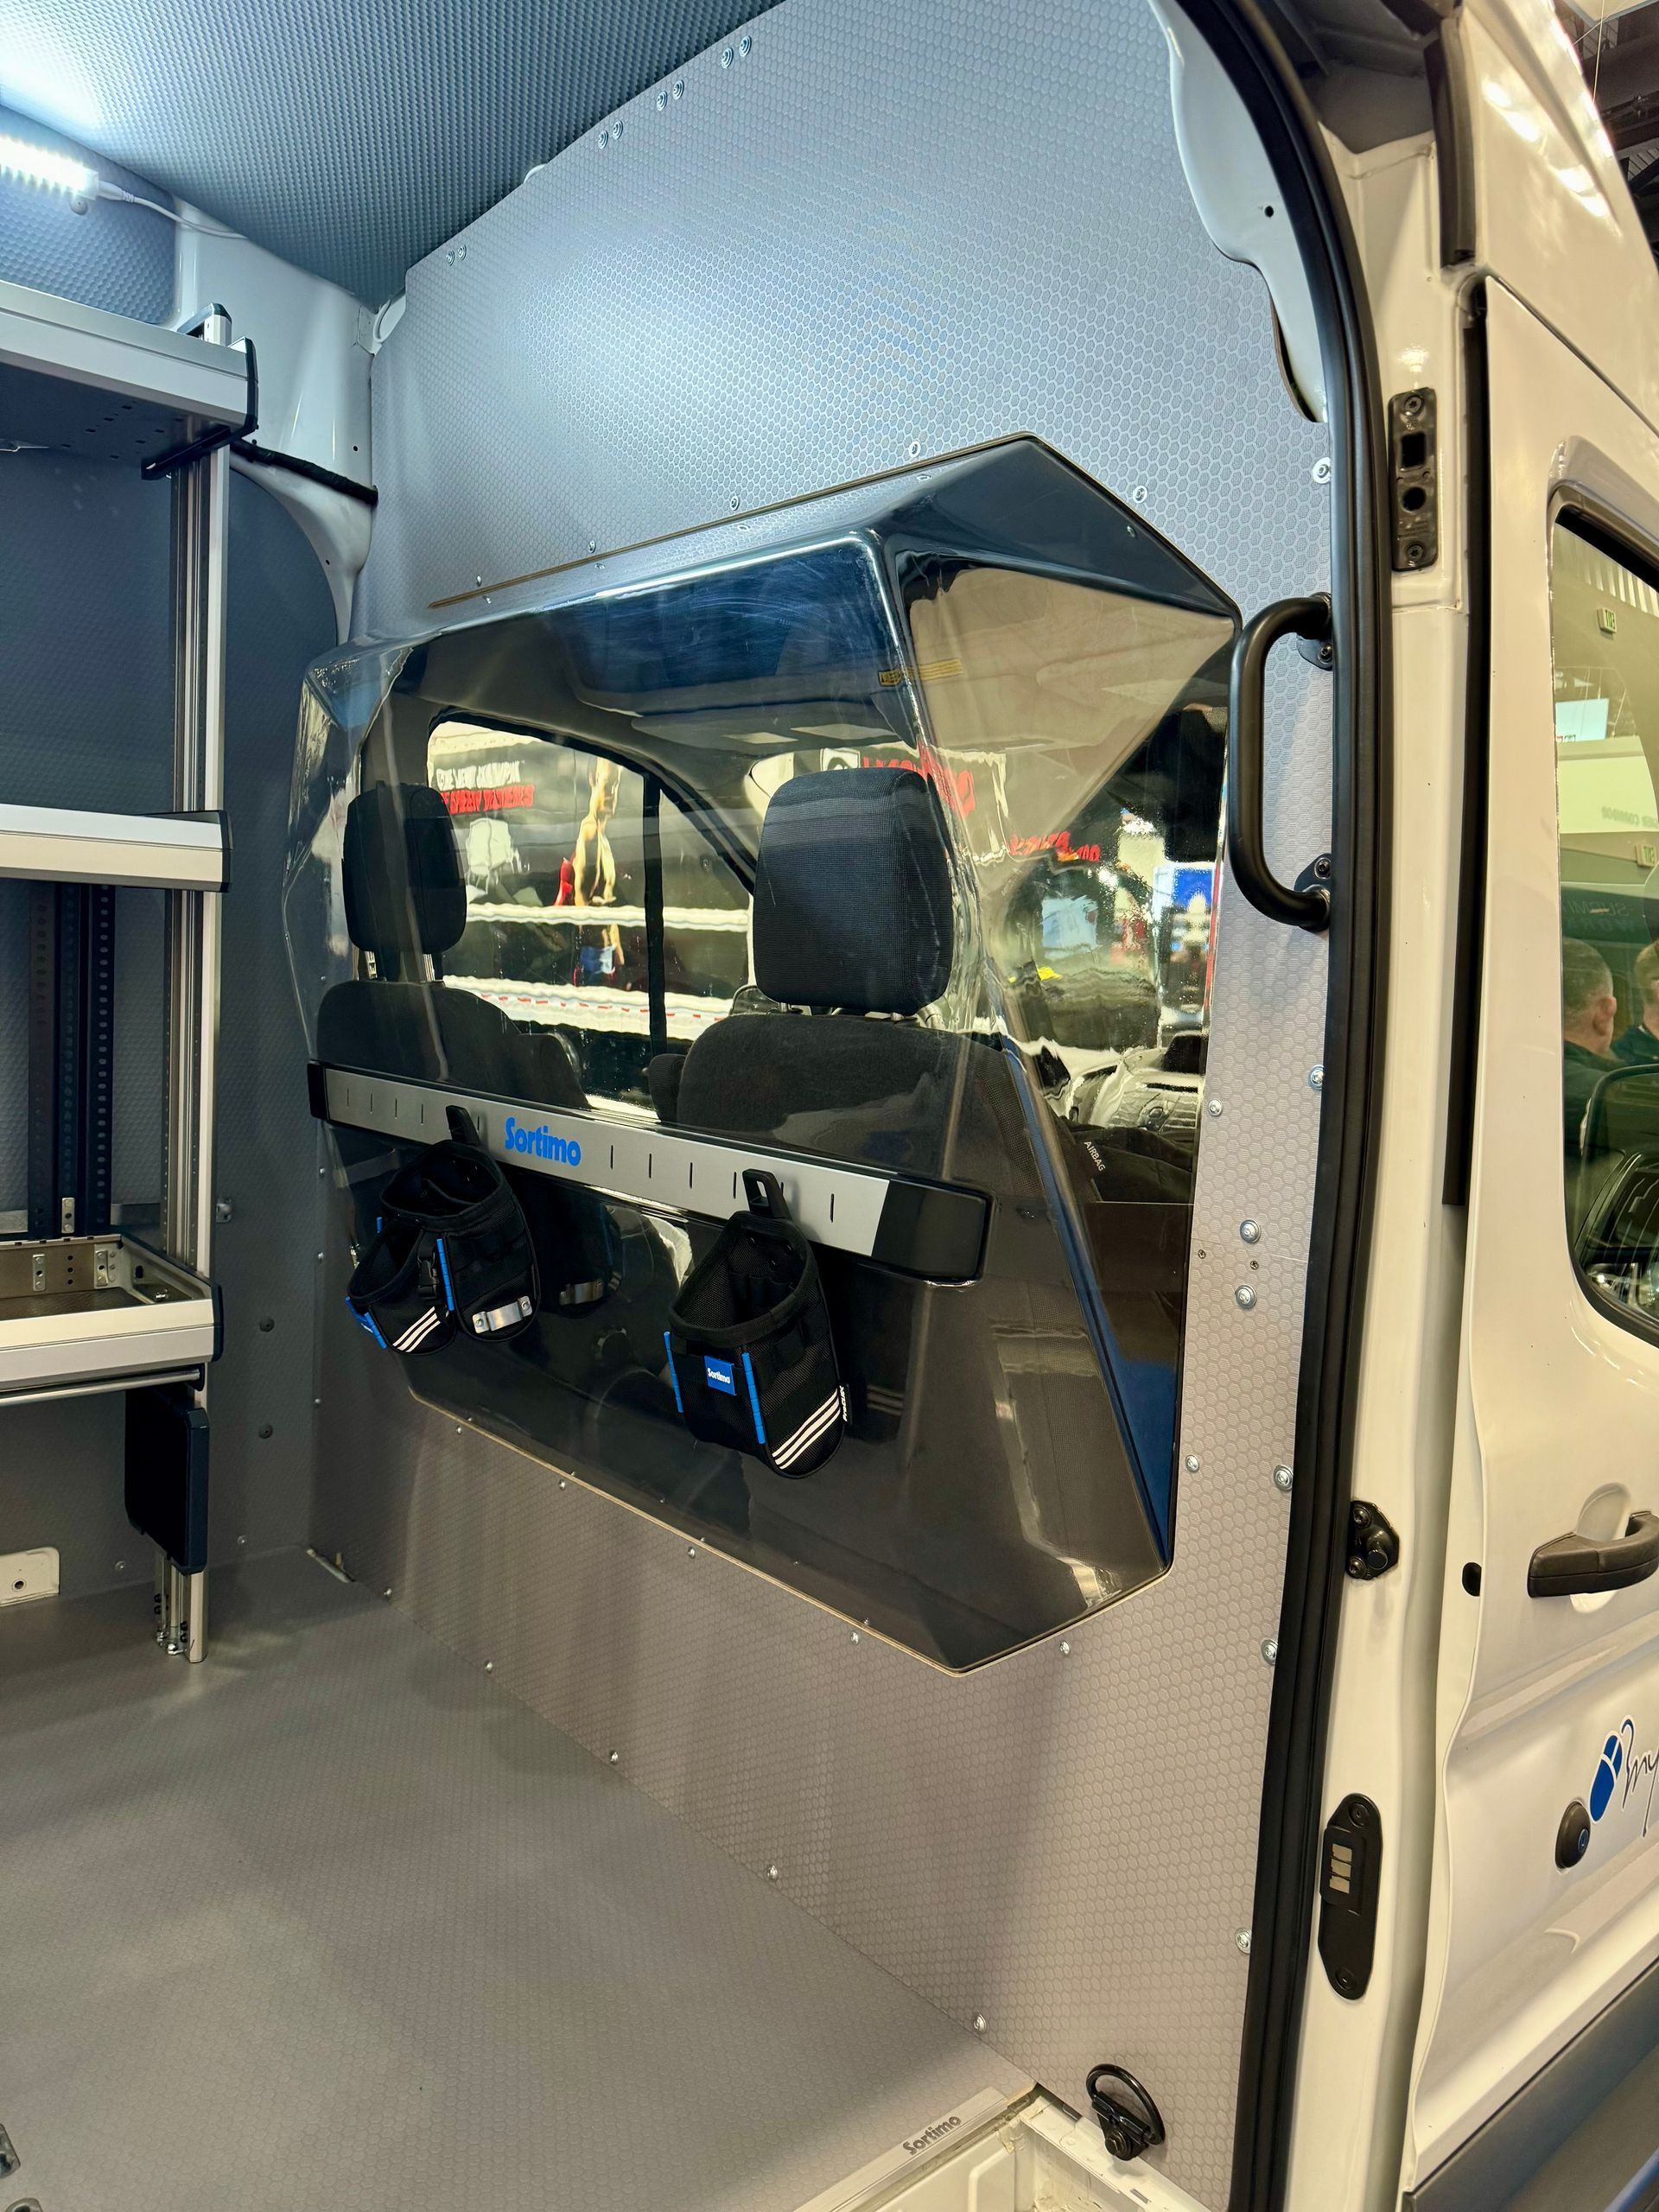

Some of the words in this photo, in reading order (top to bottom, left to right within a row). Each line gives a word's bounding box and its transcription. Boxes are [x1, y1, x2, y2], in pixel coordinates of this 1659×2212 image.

[505, 1116, 582, 1167] Sortimo
[1084, 1141, 1106, 1172] AIRBAG
[707, 1367, 731, 1384] Sortimo
[902, 2115, 962, 2156] Sortimo
